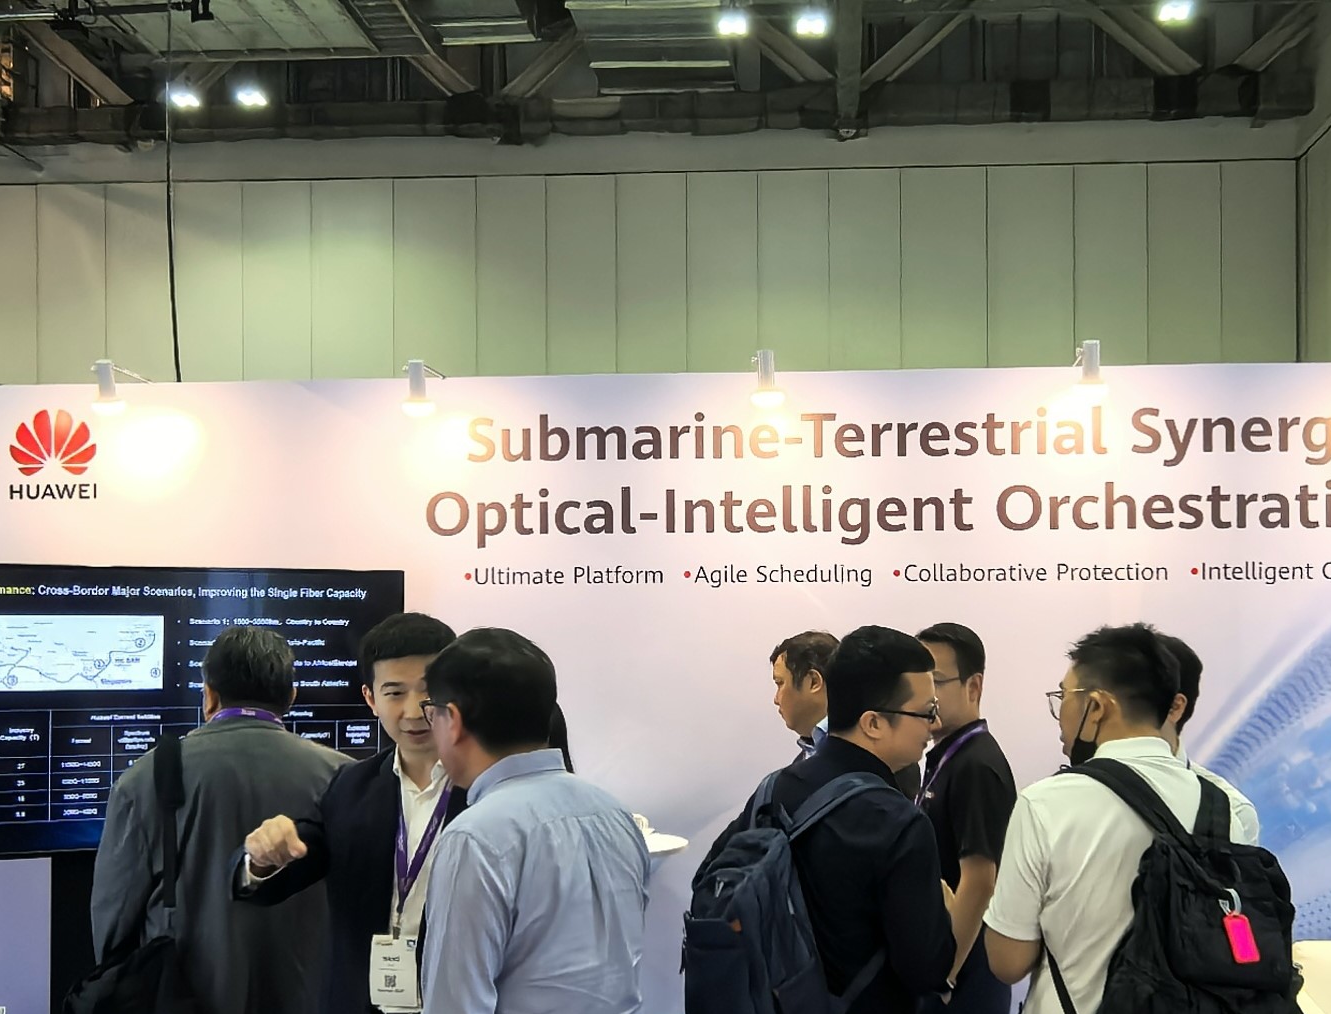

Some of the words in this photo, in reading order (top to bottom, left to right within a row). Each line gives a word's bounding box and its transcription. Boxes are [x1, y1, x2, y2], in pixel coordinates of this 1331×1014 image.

[465, 407, 1107, 463] Submarine-Terrestrial
[9, 483, 98, 500] HUAWEI
[425, 486, 974, 548] Optical-Intelligent
[474, 566, 565, 586] Ultimate
[573, 565, 664, 585] Platform
[694, 564, 749, 587] Agile
[756, 563, 873, 587] Scheduling
[904, 562, 1048, 584] Collaborative
[1056, 561, 1169, 583] Protection
[1201, 560, 1314, 584] Intelligent
[250, 587, 265, 598] the
[326, 588, 367, 600] Capacity
